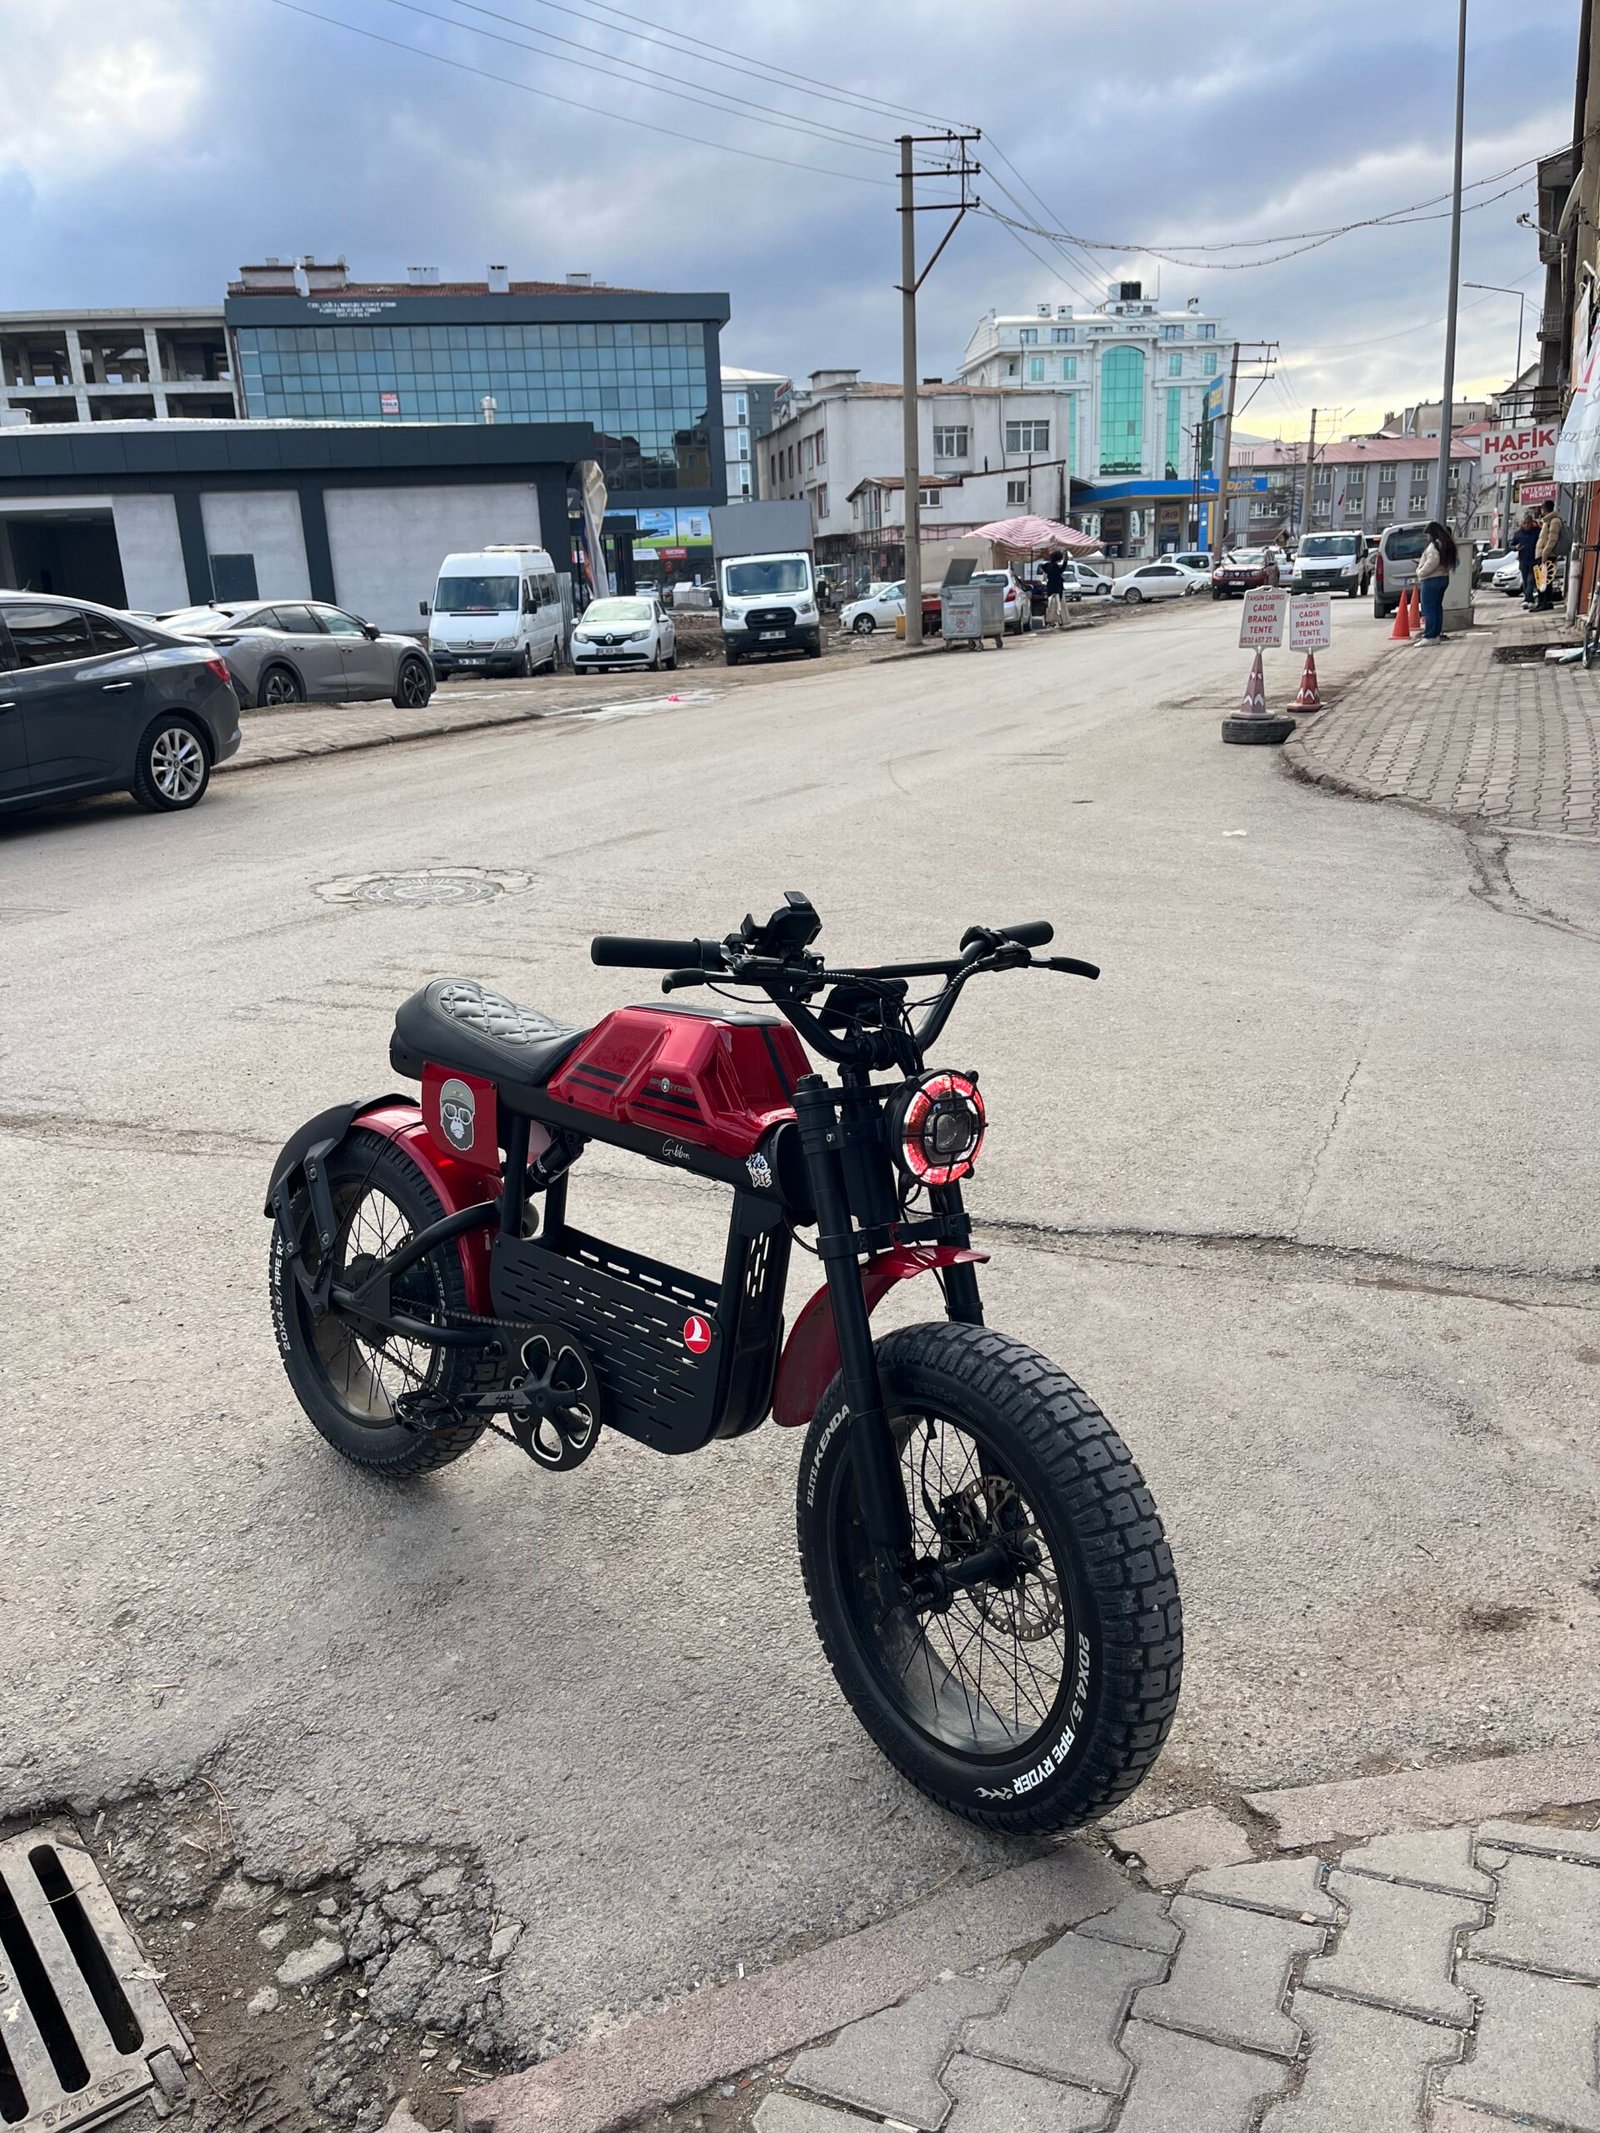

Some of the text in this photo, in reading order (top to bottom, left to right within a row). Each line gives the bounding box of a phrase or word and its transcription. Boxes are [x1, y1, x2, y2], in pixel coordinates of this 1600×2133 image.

[1484, 427, 1556, 454] HAFİK
[1500, 450, 1539, 463] KOOP
[1253, 604, 1275, 612] ÇADIR
[1247, 615, 1278, 623] BRANDA
[1299, 610, 1320, 619] ÇADIR
[1295, 620, 1324, 628] BRANDA
[1250, 626, 1273, 634] TENTE
[1299, 629, 1320, 637] TENTE
[806, 1404, 850, 1508] ELITE KENDA
[1051, 1725, 1076, 1765] APE
[1012, 1755, 1056, 1795] RYDER
